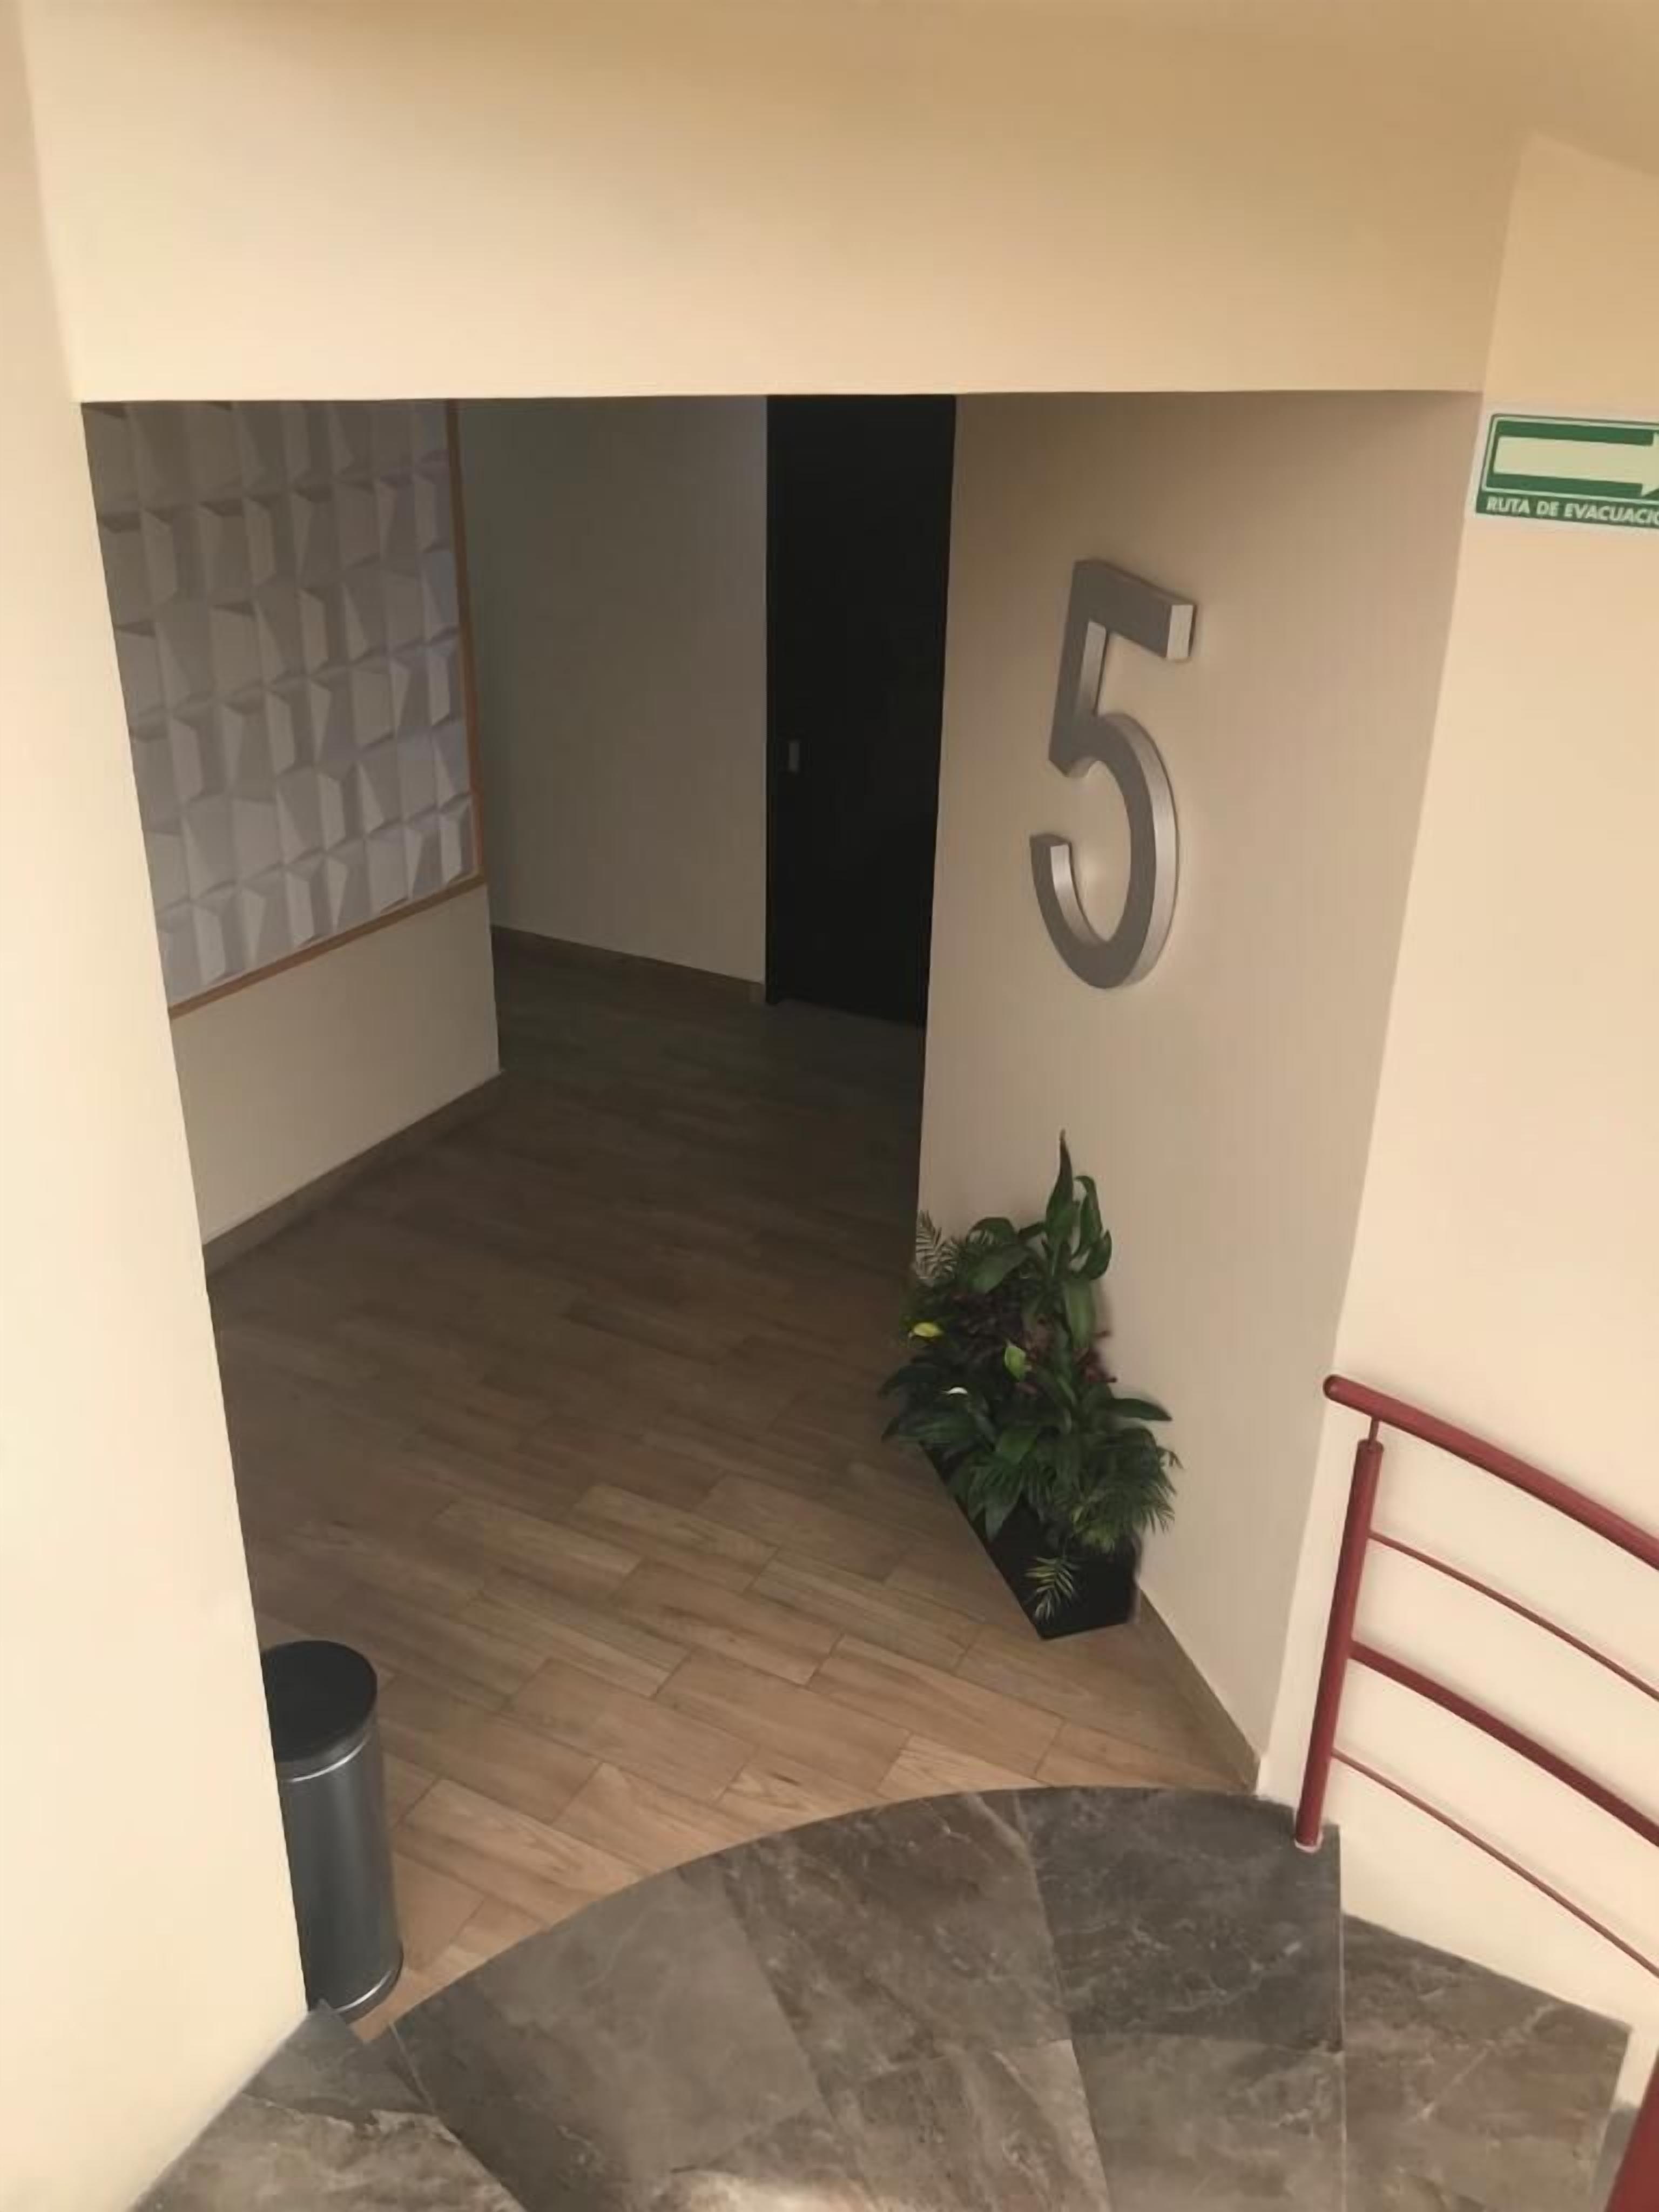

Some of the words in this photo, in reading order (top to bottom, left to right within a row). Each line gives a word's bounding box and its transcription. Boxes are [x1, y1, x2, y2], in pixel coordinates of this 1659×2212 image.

[1486, 496, 1530, 514] RUTA
[1536, 500, 1559, 516] DE
[1029, 558, 1196, 989] 5
